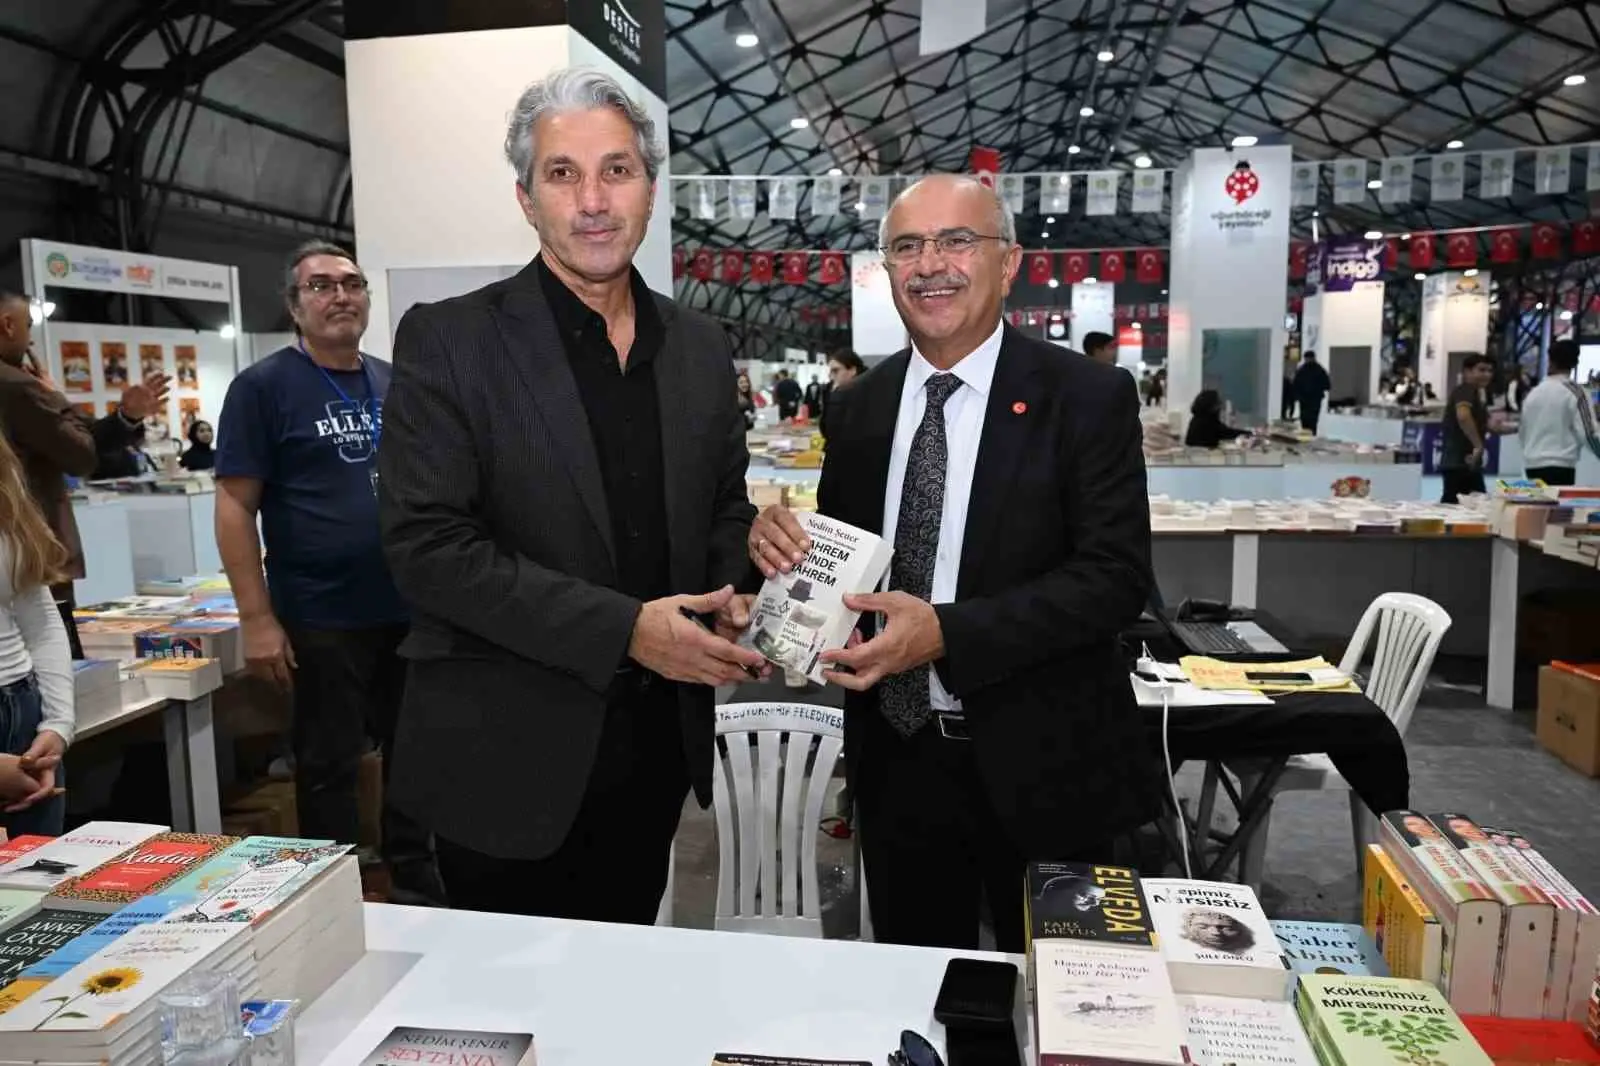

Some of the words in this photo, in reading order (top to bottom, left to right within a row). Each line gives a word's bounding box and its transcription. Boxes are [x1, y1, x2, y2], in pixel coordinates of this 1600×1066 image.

[808, 539, 850, 563] AHREM
[1094, 864, 1146, 933] ELVEDA
[1322, 985, 1431, 1003] Köklerimiz
[1321, 998, 1449, 1016] Mirasımızdır
